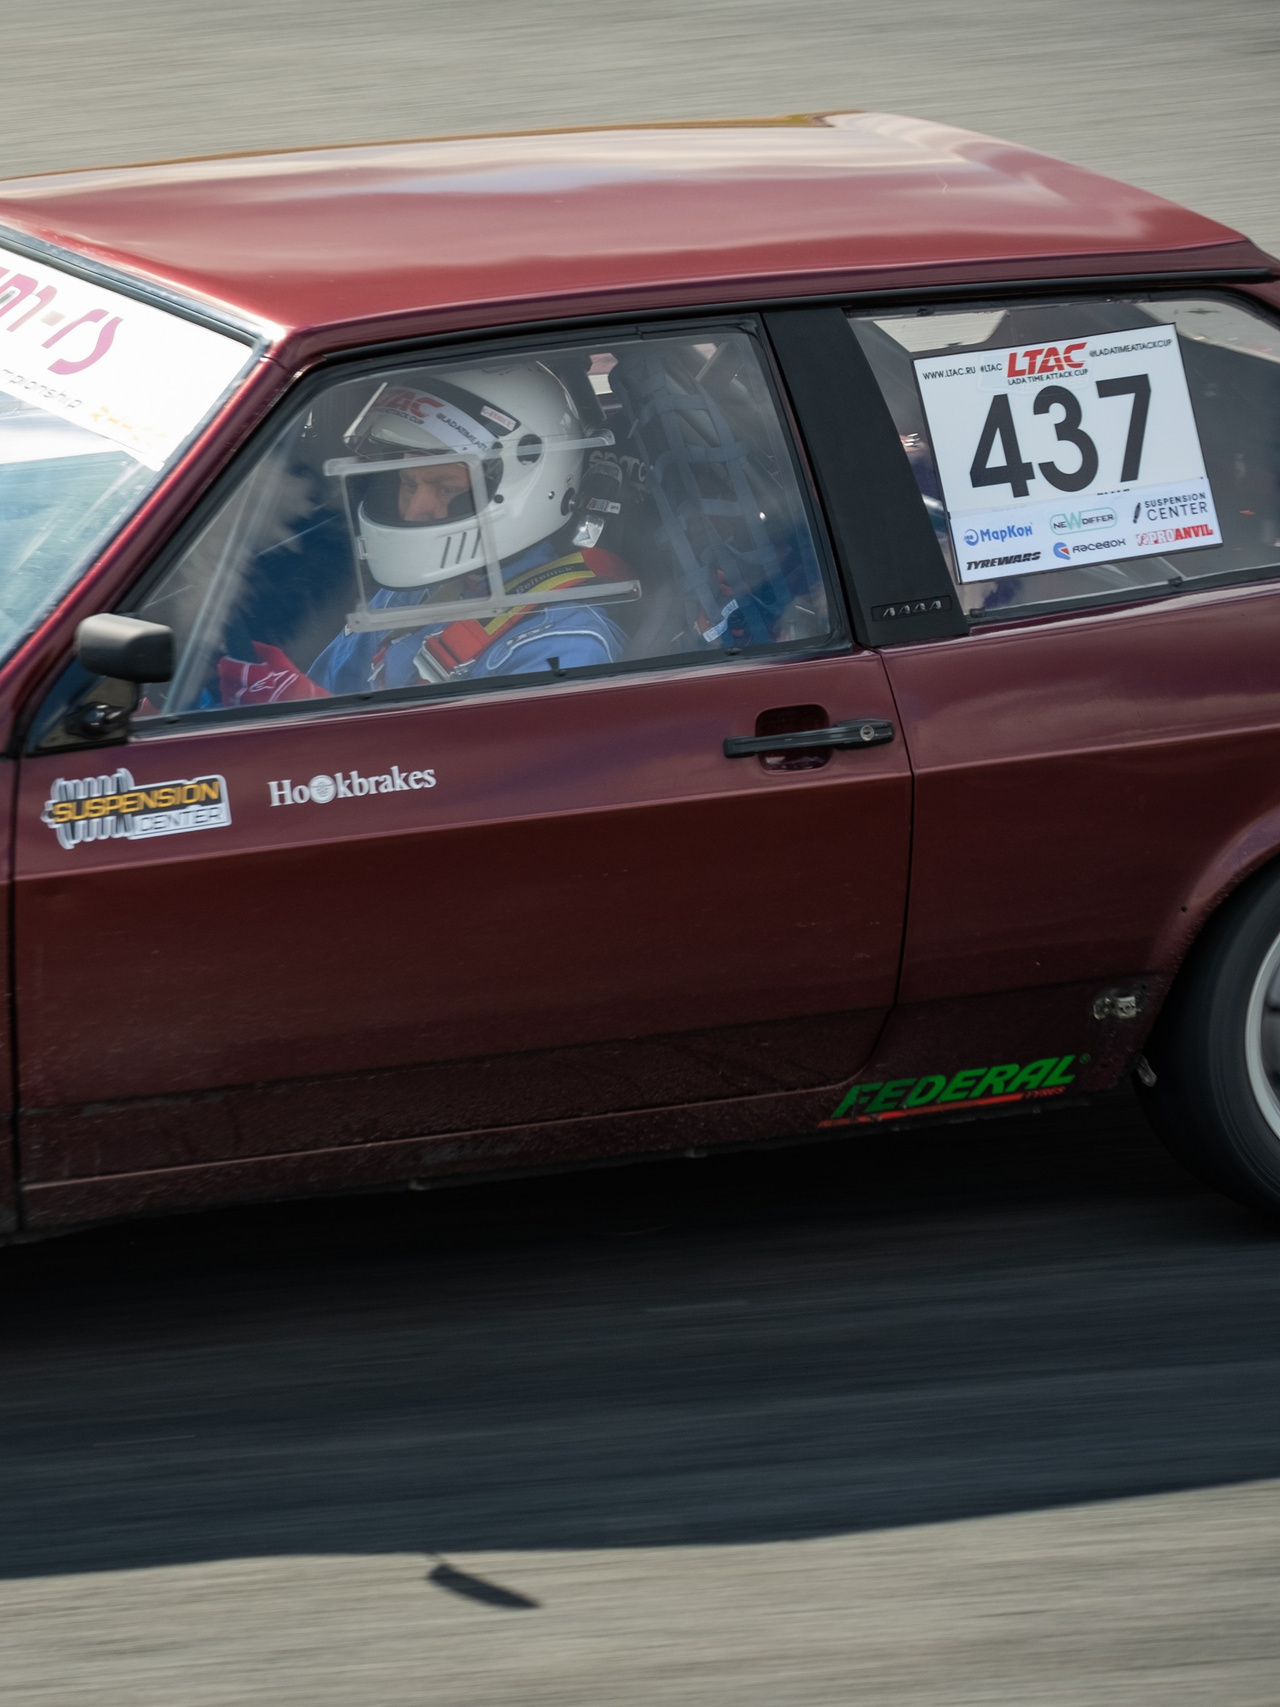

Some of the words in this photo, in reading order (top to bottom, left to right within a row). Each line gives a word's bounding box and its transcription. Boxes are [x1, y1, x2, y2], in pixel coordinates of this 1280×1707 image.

[1007, 342, 1087, 378] LTAC
[922, 366, 976, 380] WWW.LTAC.RU
[1008, 377, 1027, 386] LADA
[1027, 374, 1045, 383] TIME
[1045, 371, 1074, 381] ATTACK
[1074, 368, 1089, 377] CUP
[970, 373, 1151, 498] 437
[1144, 492, 1206, 508] SUSPENSION
[1082, 514, 1114, 525] DIFFER
[1146, 502, 1208, 522] CENTER
[966, 551, 1041, 571] TYREWARS
[52, 781, 220, 824] SUSPENSION
[139, 806, 222, 832] CENTER
[831, 1055, 1075, 1118] FEDERAL
